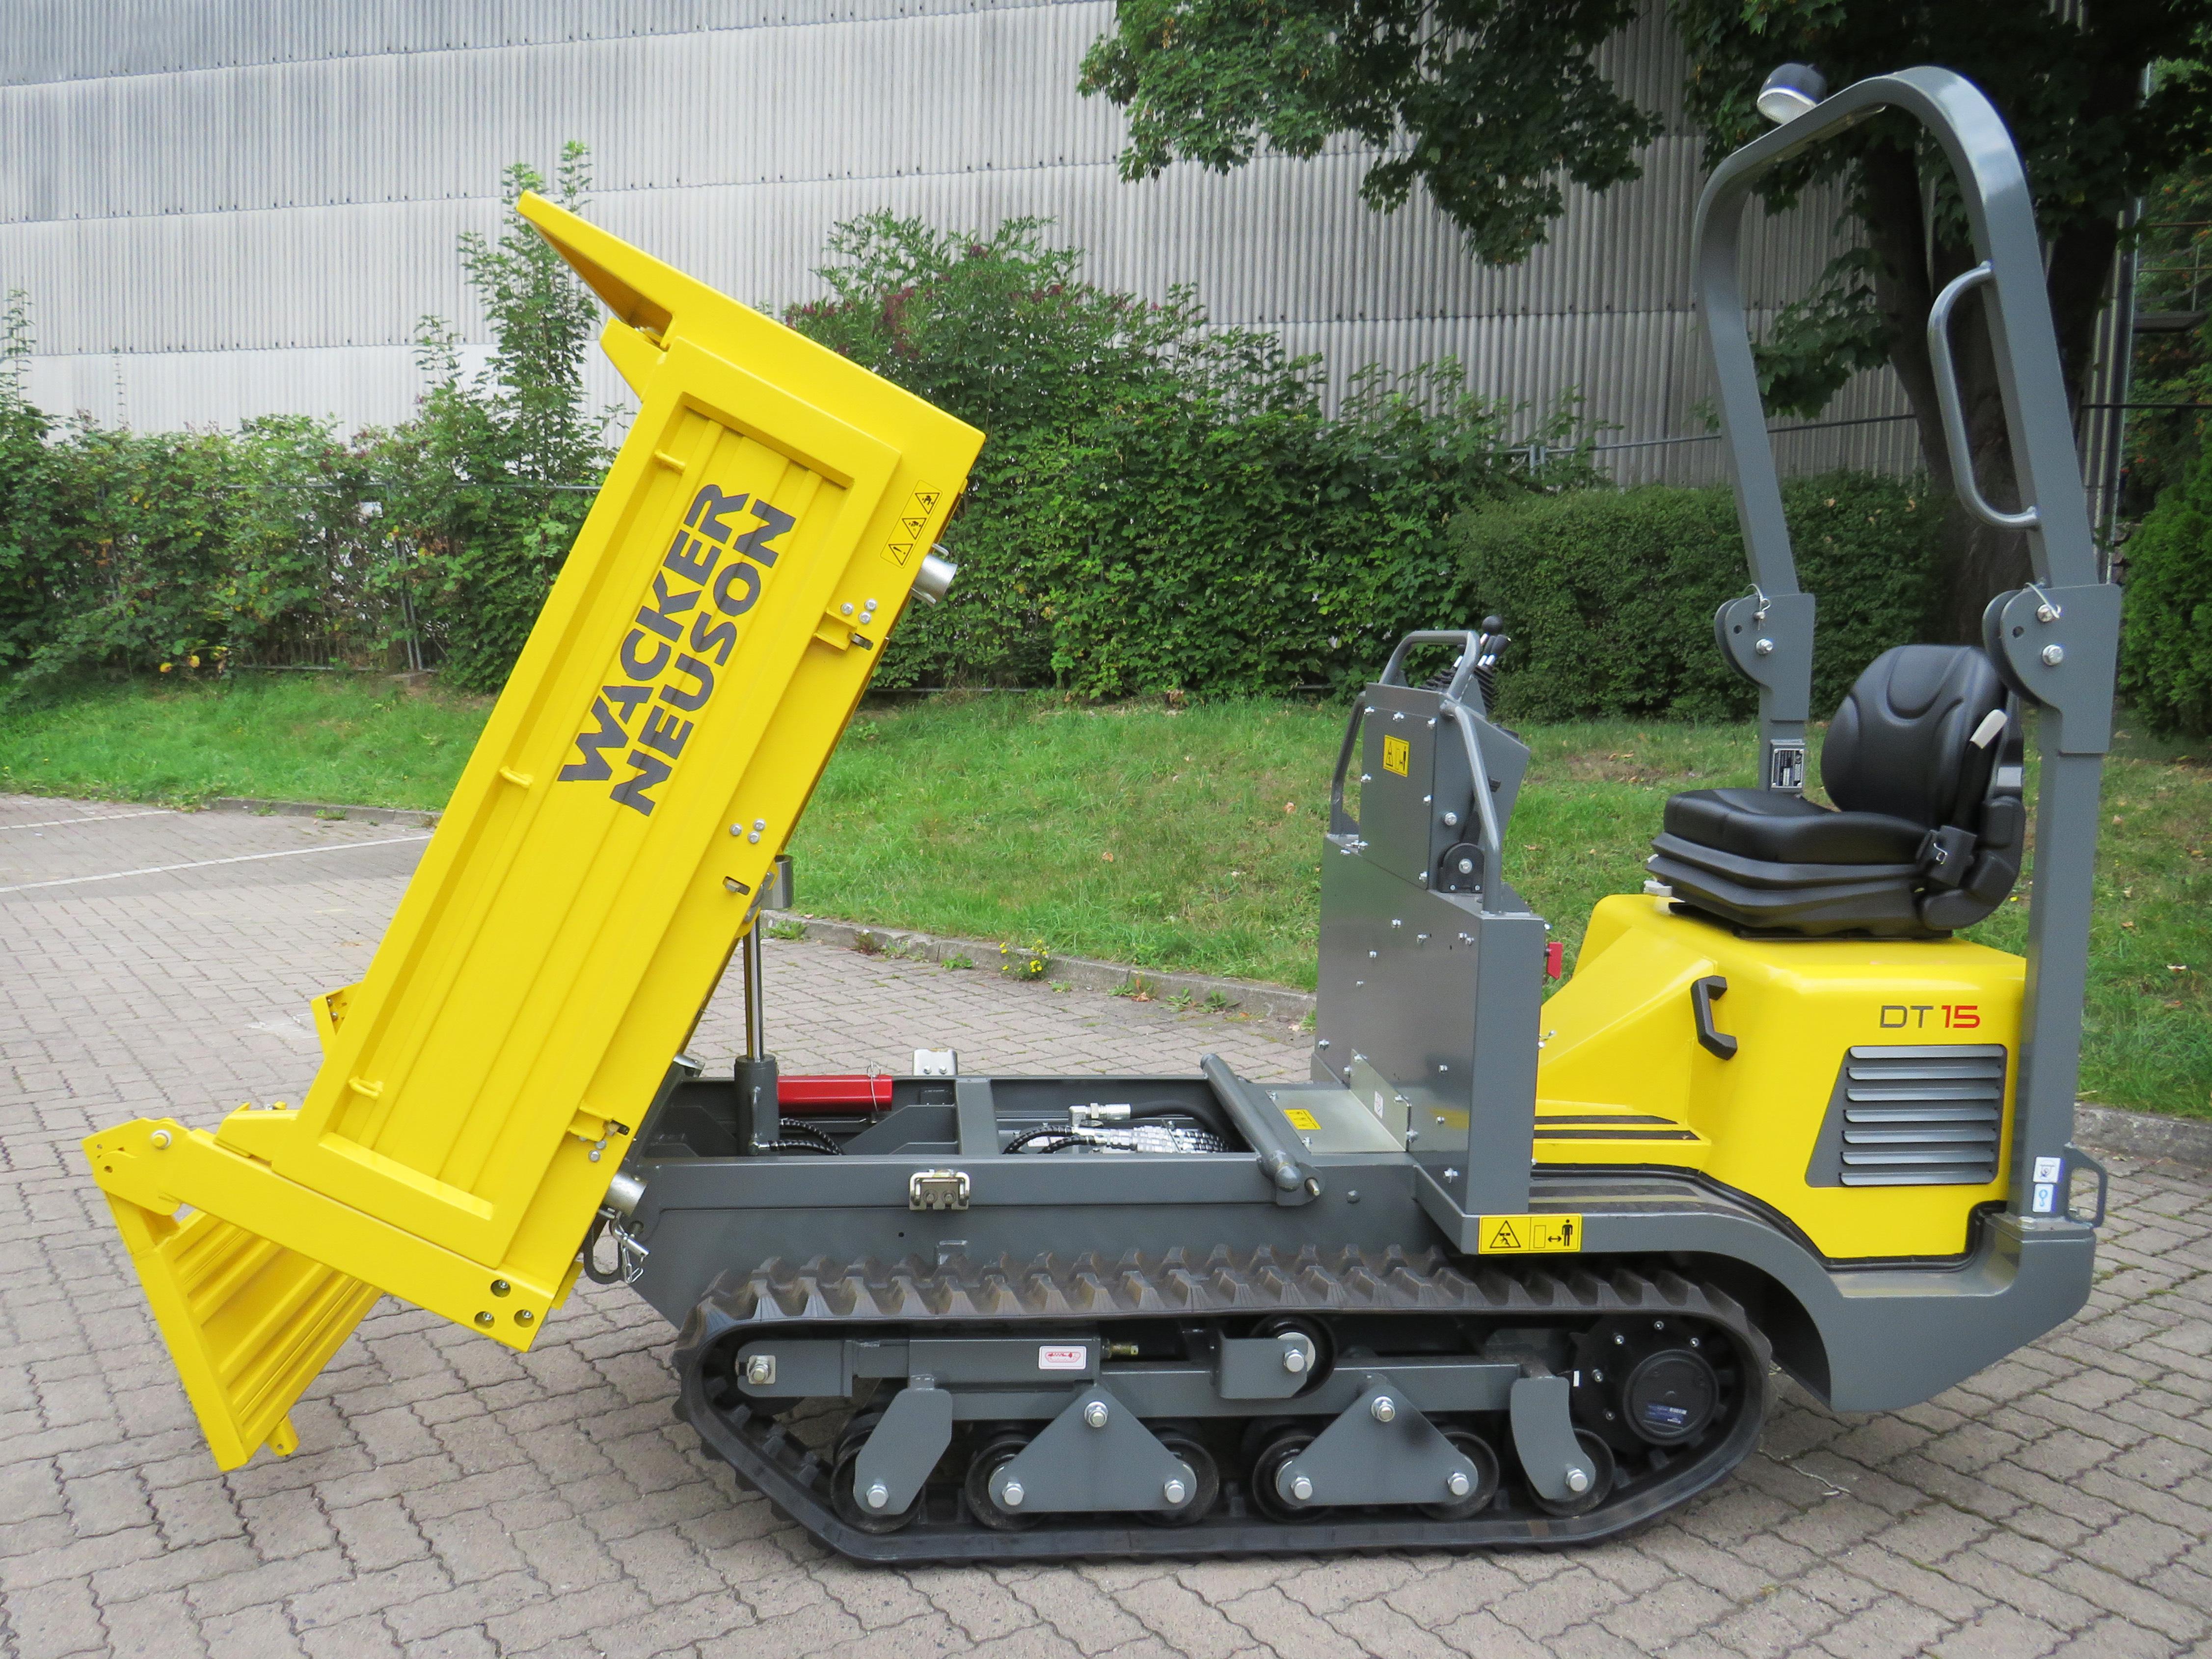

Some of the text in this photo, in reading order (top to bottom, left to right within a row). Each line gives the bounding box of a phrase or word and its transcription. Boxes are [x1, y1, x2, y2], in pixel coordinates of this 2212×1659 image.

[558, 483, 750, 781] WACKER
[610, 499, 796, 816] NEUSON
[1880, 1004, 1981, 1029] DT 15
